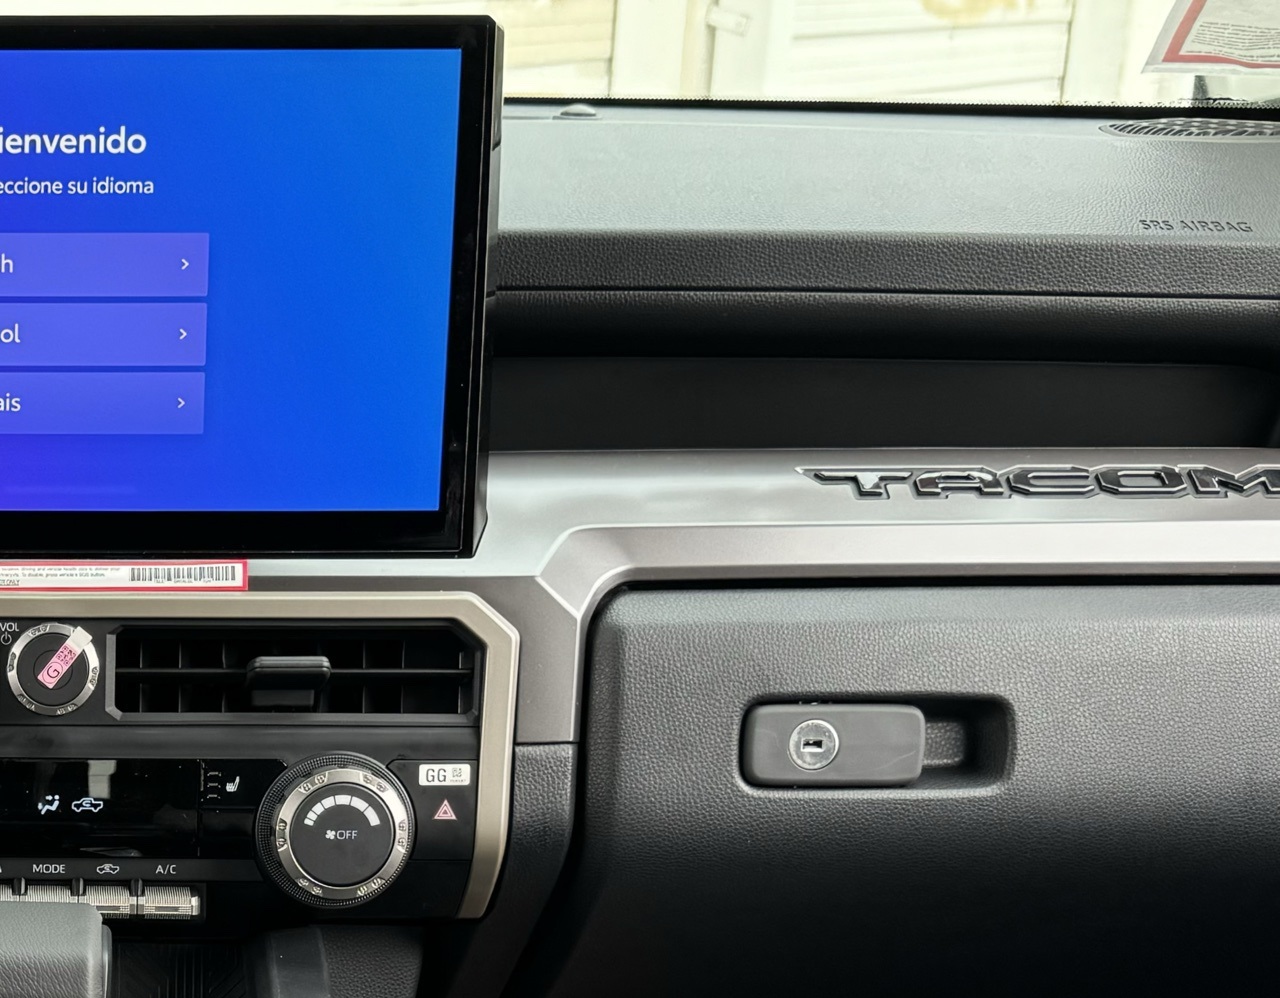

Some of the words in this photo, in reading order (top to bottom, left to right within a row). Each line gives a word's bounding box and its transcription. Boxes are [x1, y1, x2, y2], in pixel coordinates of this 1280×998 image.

[67, 180, 88, 195] su
[92, 176, 155, 195] idioma
[1138, 219, 1175, 231] SRS
[1179, 220, 1254, 232] AIRBAG
[0, 622, 20, 632] VOL
[46, 665, 61, 679] G
[425, 767, 447, 783] GG
[336, 830, 358, 840] OFF
[32, 864, 66, 874] MODE
[155, 864, 177, 874] A/C
